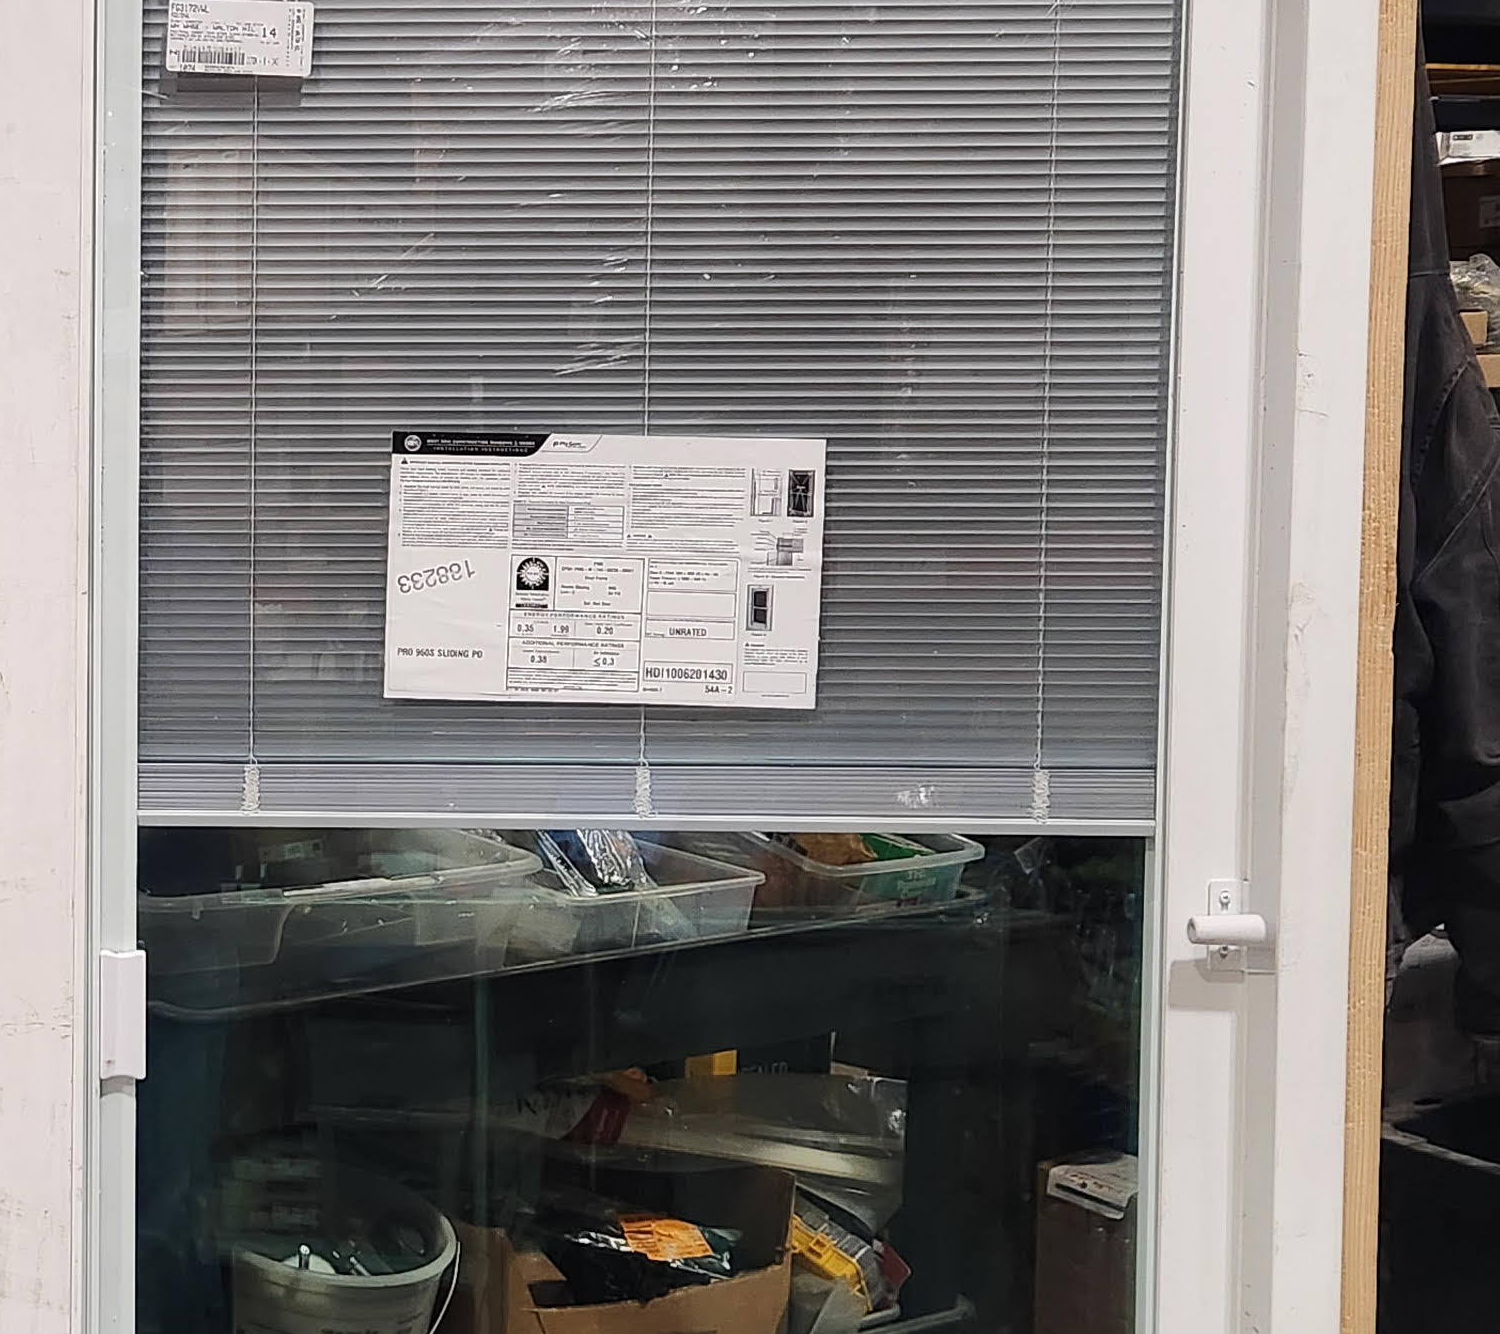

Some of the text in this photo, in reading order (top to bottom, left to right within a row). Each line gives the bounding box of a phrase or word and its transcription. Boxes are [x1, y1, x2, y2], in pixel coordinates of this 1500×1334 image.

[262, 27, 277, 38] 14
[669, 627, 707, 636] UNRATED
[397, 647, 413, 656] PRO
[437, 649, 469, 658] SLIDING
